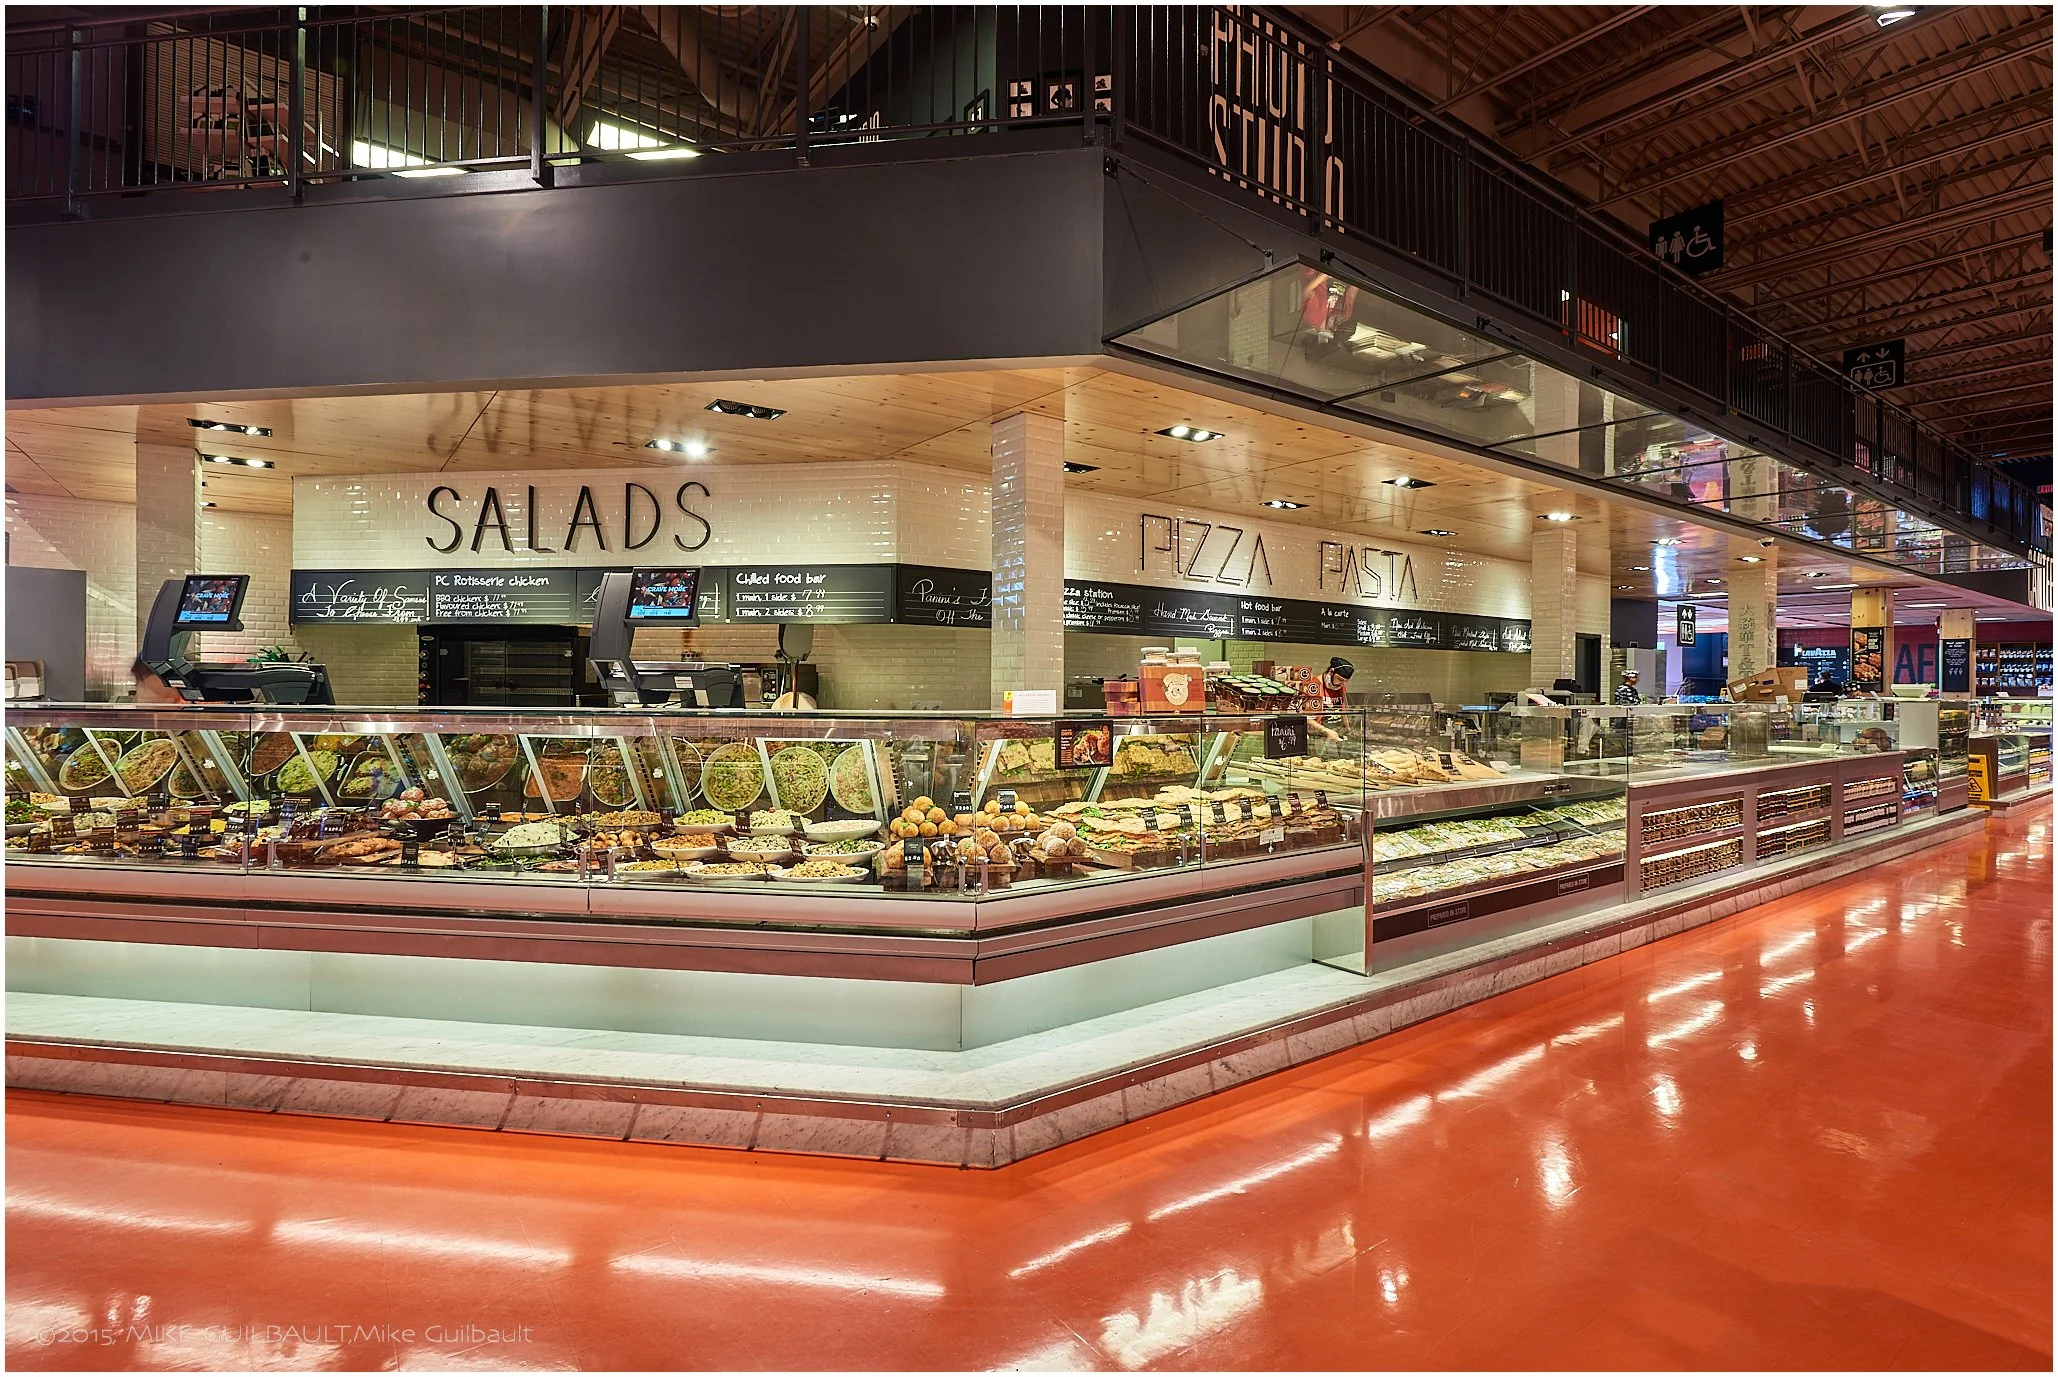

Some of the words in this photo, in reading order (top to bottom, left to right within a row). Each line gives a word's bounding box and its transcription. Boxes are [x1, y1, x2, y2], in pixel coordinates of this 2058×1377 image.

[1209, 94, 1344, 233] STUDO
[426, 482, 712, 554] SALADS
[1141, 513, 1273, 587] PIZZA
[1320, 540, 1418, 601] PASTA
[435, 575, 450, 586] PC
[454, 574, 505, 587] Rotisserie
[508, 575, 549, 587] chicken
[736, 572, 770, 585] Chilled
[774, 572, 802, 585] food
[806, 572, 827, 584] bar
[301, 582, 318, 604] A
[646, 585, 667, 593] CRAVE
[1063, 587, 1081, 597] zza
[1084, 587, 1114, 599] station
[435, 594, 451, 602] BBQ
[435, 609, 452, 618] Free
[454, 609, 473, 617] from
[1241, 600, 1253, 611] Hot
[1254, 602, 1270, 612] food
[1271, 604, 1283, 613] bar
[1767, 602, 1776, 666] sush
[1269, 721, 1296, 737] Panini
[1430, 911, 1450, 921] PREPARED
[1450, 906, 1467, 917] IN-STORE
